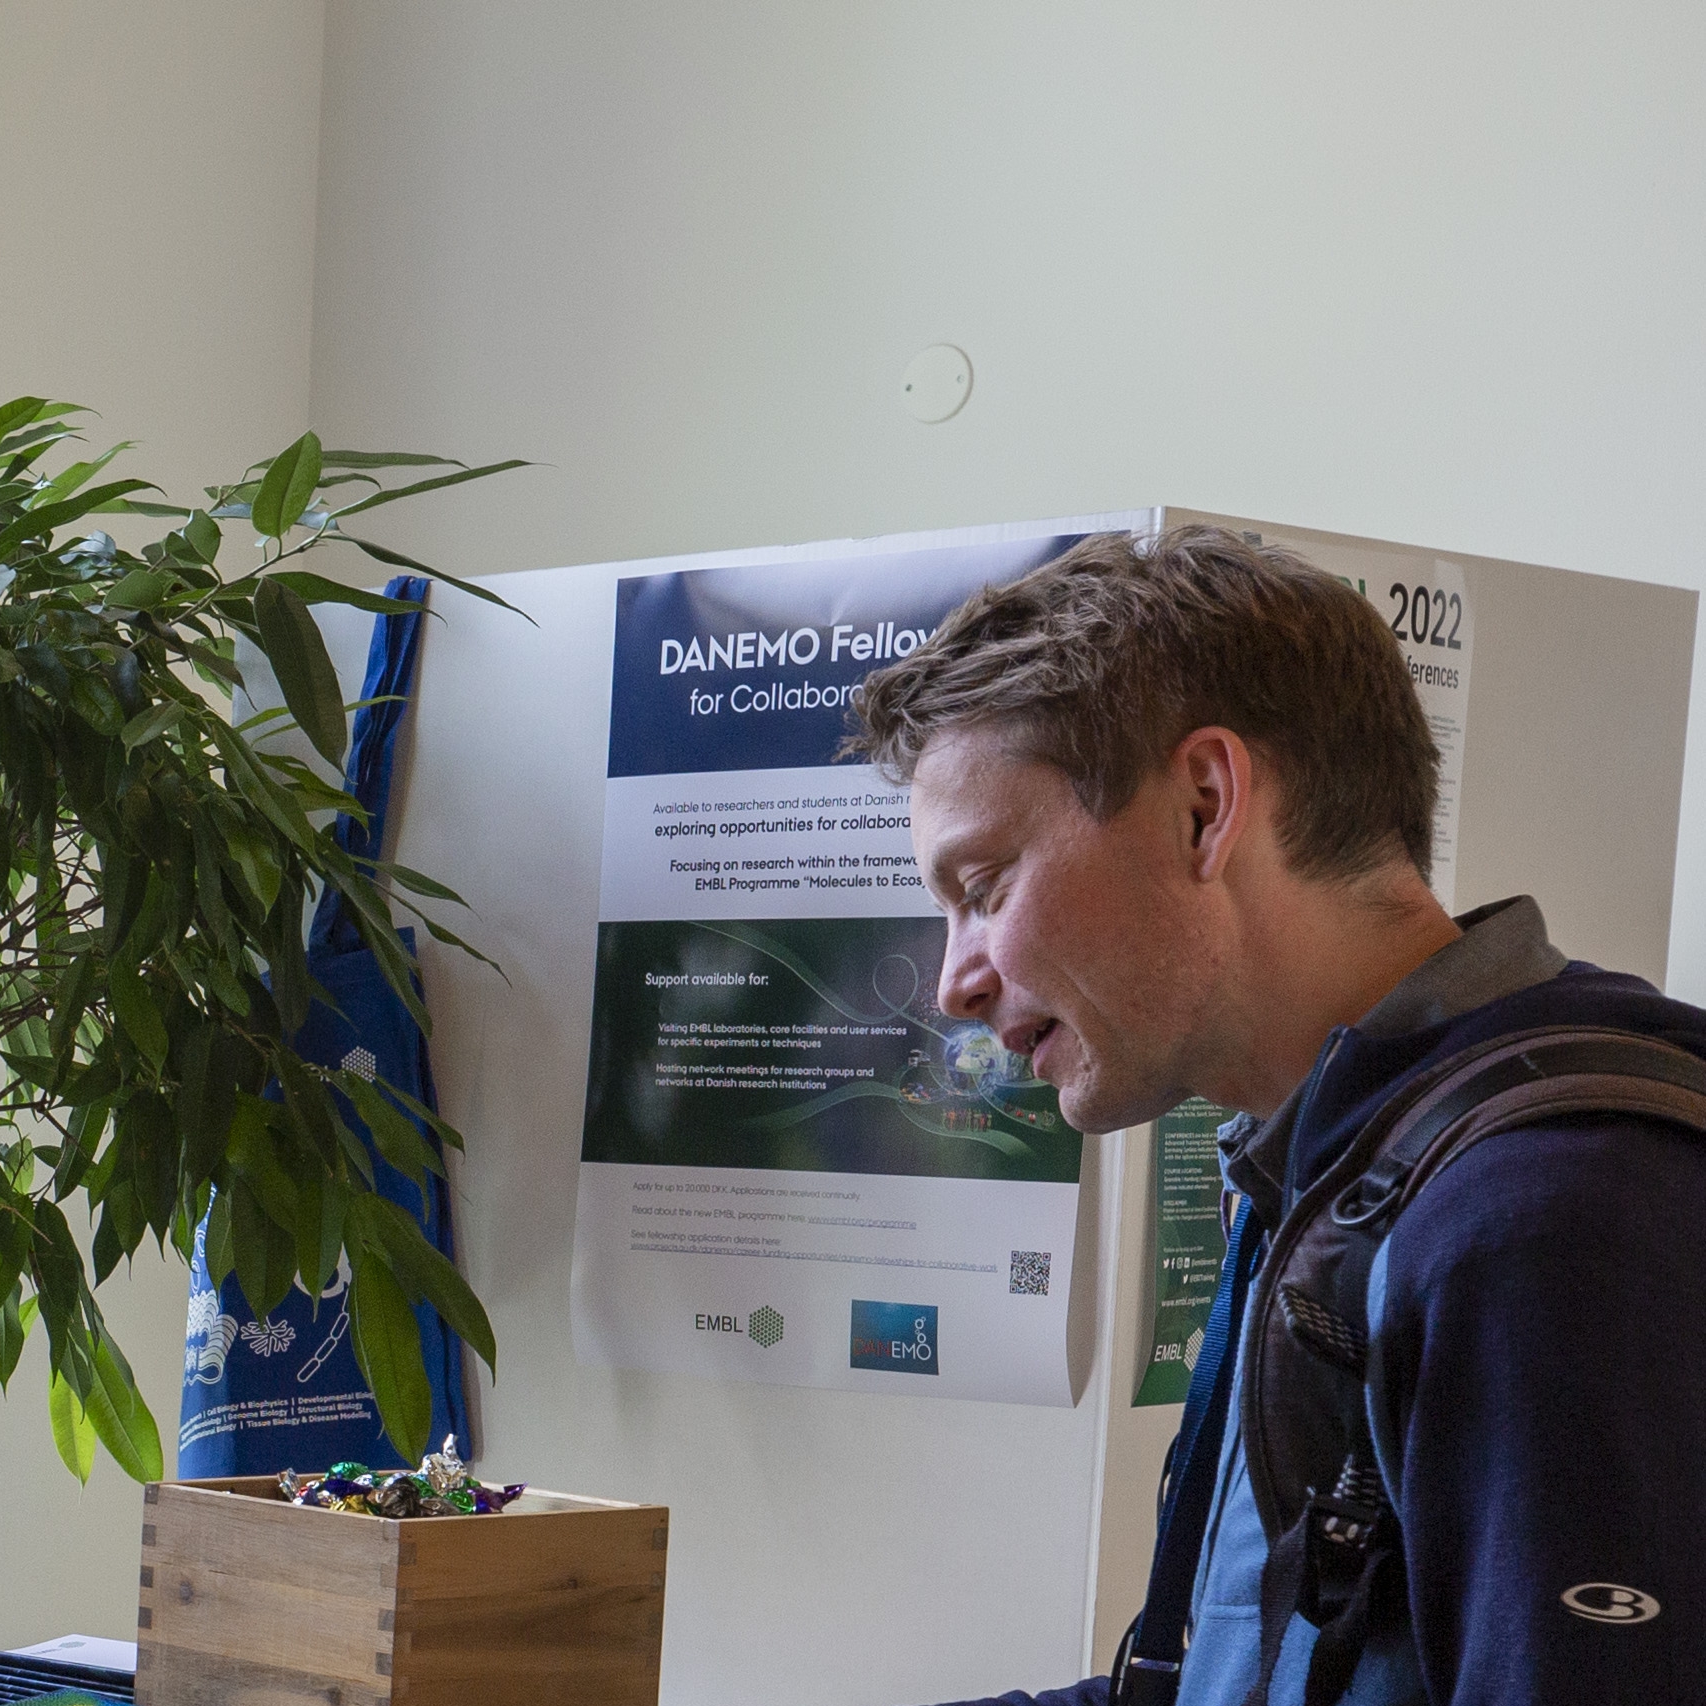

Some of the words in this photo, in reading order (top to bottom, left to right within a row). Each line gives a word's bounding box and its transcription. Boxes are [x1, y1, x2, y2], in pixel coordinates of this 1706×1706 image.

[1389, 582, 1462, 650] 2022
[660, 626, 820, 675] DANEMO
[690, 688, 723, 716] for
[653, 801, 699, 815] Available
[702, 802, 712, 813] to
[714, 799, 775, 813] researchers
[777, 798, 799, 811] and
[801, 795, 848, 809] students
[851, 796, 862, 808] at
[865, 793, 904, 807] Danish
[655, 822, 716, 838] exploring
[719, 818, 814, 837] opportunities
[817, 817, 838, 832] for
[670, 858, 720, 874] Focusing
[723, 860, 739, 872] on
[741, 856, 795, 870] research
[797, 855, 836, 869] within
[838, 855, 861, 868] the
[695, 877, 727, 891] EMBL
[729, 876, 800, 893] Programme
[803, 875, 873, 889] “Molecules
[876, 875, 889, 888] to
[645, 972, 689, 988] Support
[691, 972, 746, 987] available
[748, 972, 770, 986] for:
[659, 1023, 688, 1034] Visiting
[689, 1023, 712, 1034] EMBL
[792, 1025, 828, 1035] facilities
[830, 1025, 848, 1035] and
[849, 1027, 869, 1035] user
[870, 1026, 908, 1036] services
[658, 1037, 669, 1047] for
[670, 1036, 702, 1048] specific
[704, 1037, 759, 1049] experiments
[761, 1039, 770, 1047] or
[772, 1038, 822, 1050] techniques
[656, 1063, 687, 1076] Hosting
[689, 1064, 724, 1075] network
[726, 1065, 769, 1077] meetings
[770, 1065, 783, 1075] for
[784, 1066, 823, 1077] research
[824, 1067, 855, 1079] groups
[856, 1067, 874, 1078] and
[655, 1077, 693, 1088] networks
[695, 1077, 705, 1088] at
[706, 1077, 737, 1088] Danish
[739, 1078, 778, 1089] research
[779, 1079, 827, 1090] institutions
[647, 1230, 687, 1243] fellowship
[688, 1231, 732, 1244] application
[695, 1314, 743, 1333] EMBL
[852, 1336, 932, 1362] DANEMO
[1154, 1343, 1183, 1362] EMBL
[248, 1398, 289, 1410] Biophysics
[298, 1392, 355, 1405] Developmental
[297, 1403, 337, 1414] Structural
[337, 1401, 364, 1412] Biology
[247, 1418, 272, 1428] Tissue
[272, 1416, 300, 1428] Biology
[309, 1412, 339, 1424] Disease
[340, 1409, 372, 1421] Modelling
